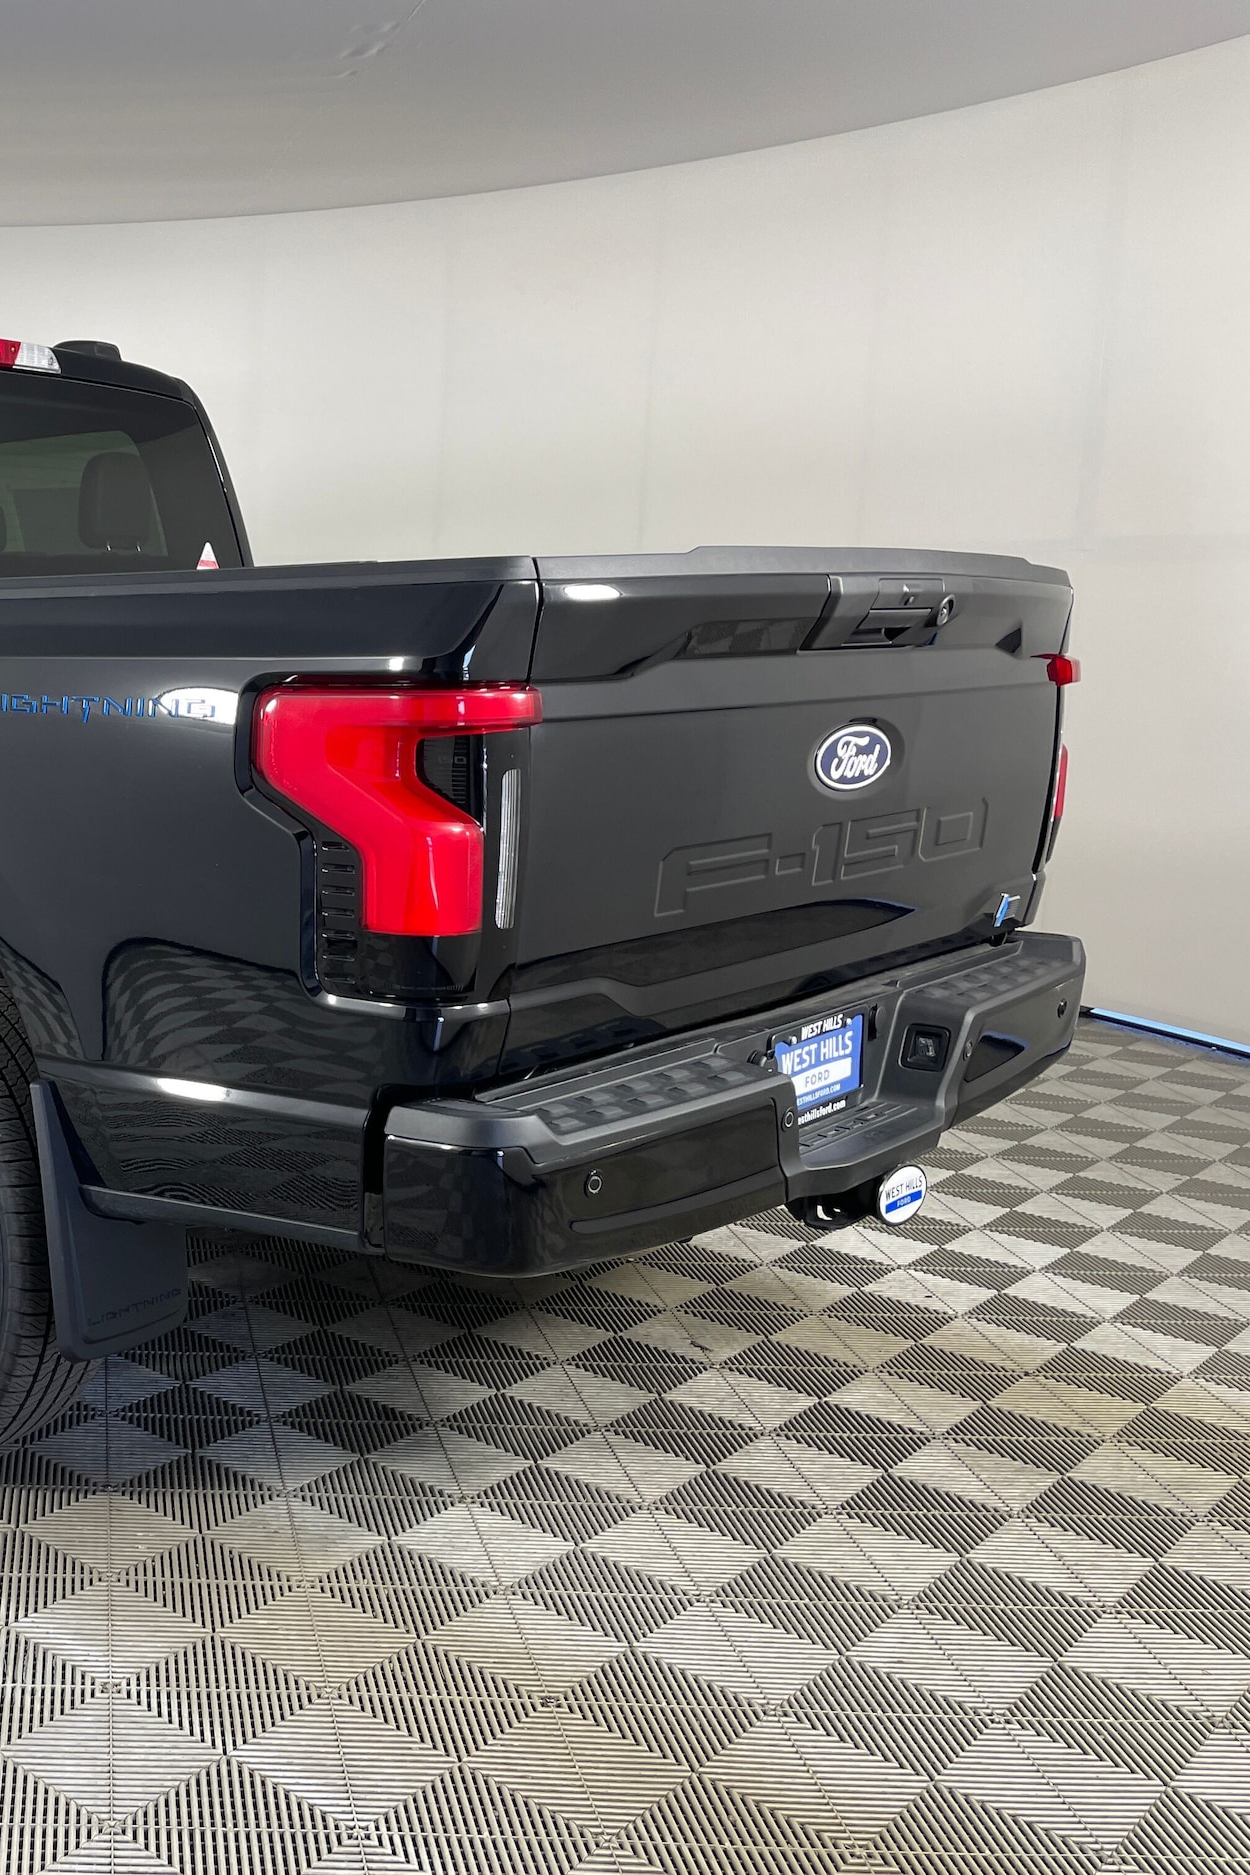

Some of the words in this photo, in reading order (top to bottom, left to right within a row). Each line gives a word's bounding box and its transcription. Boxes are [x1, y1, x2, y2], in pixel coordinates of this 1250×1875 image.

[830, 735, 881, 780] Ford
[654, 797, 990, 918] F-150
[801, 1020, 823, 1041] WEST
[822, 1013, 844, 1032] HILLS
[781, 1043, 818, 1076] WEST
[820, 1030, 853, 1062] HILLS
[804, 1069, 830, 1089] FORD
[796, 1083, 841, 1106] ESTHILLSFORD.COM
[797, 1099, 847, 1126] esthillsford.com
[885, 1183, 904, 1202] WEST
[87, 1287, 183, 1327] LIGHTNING
